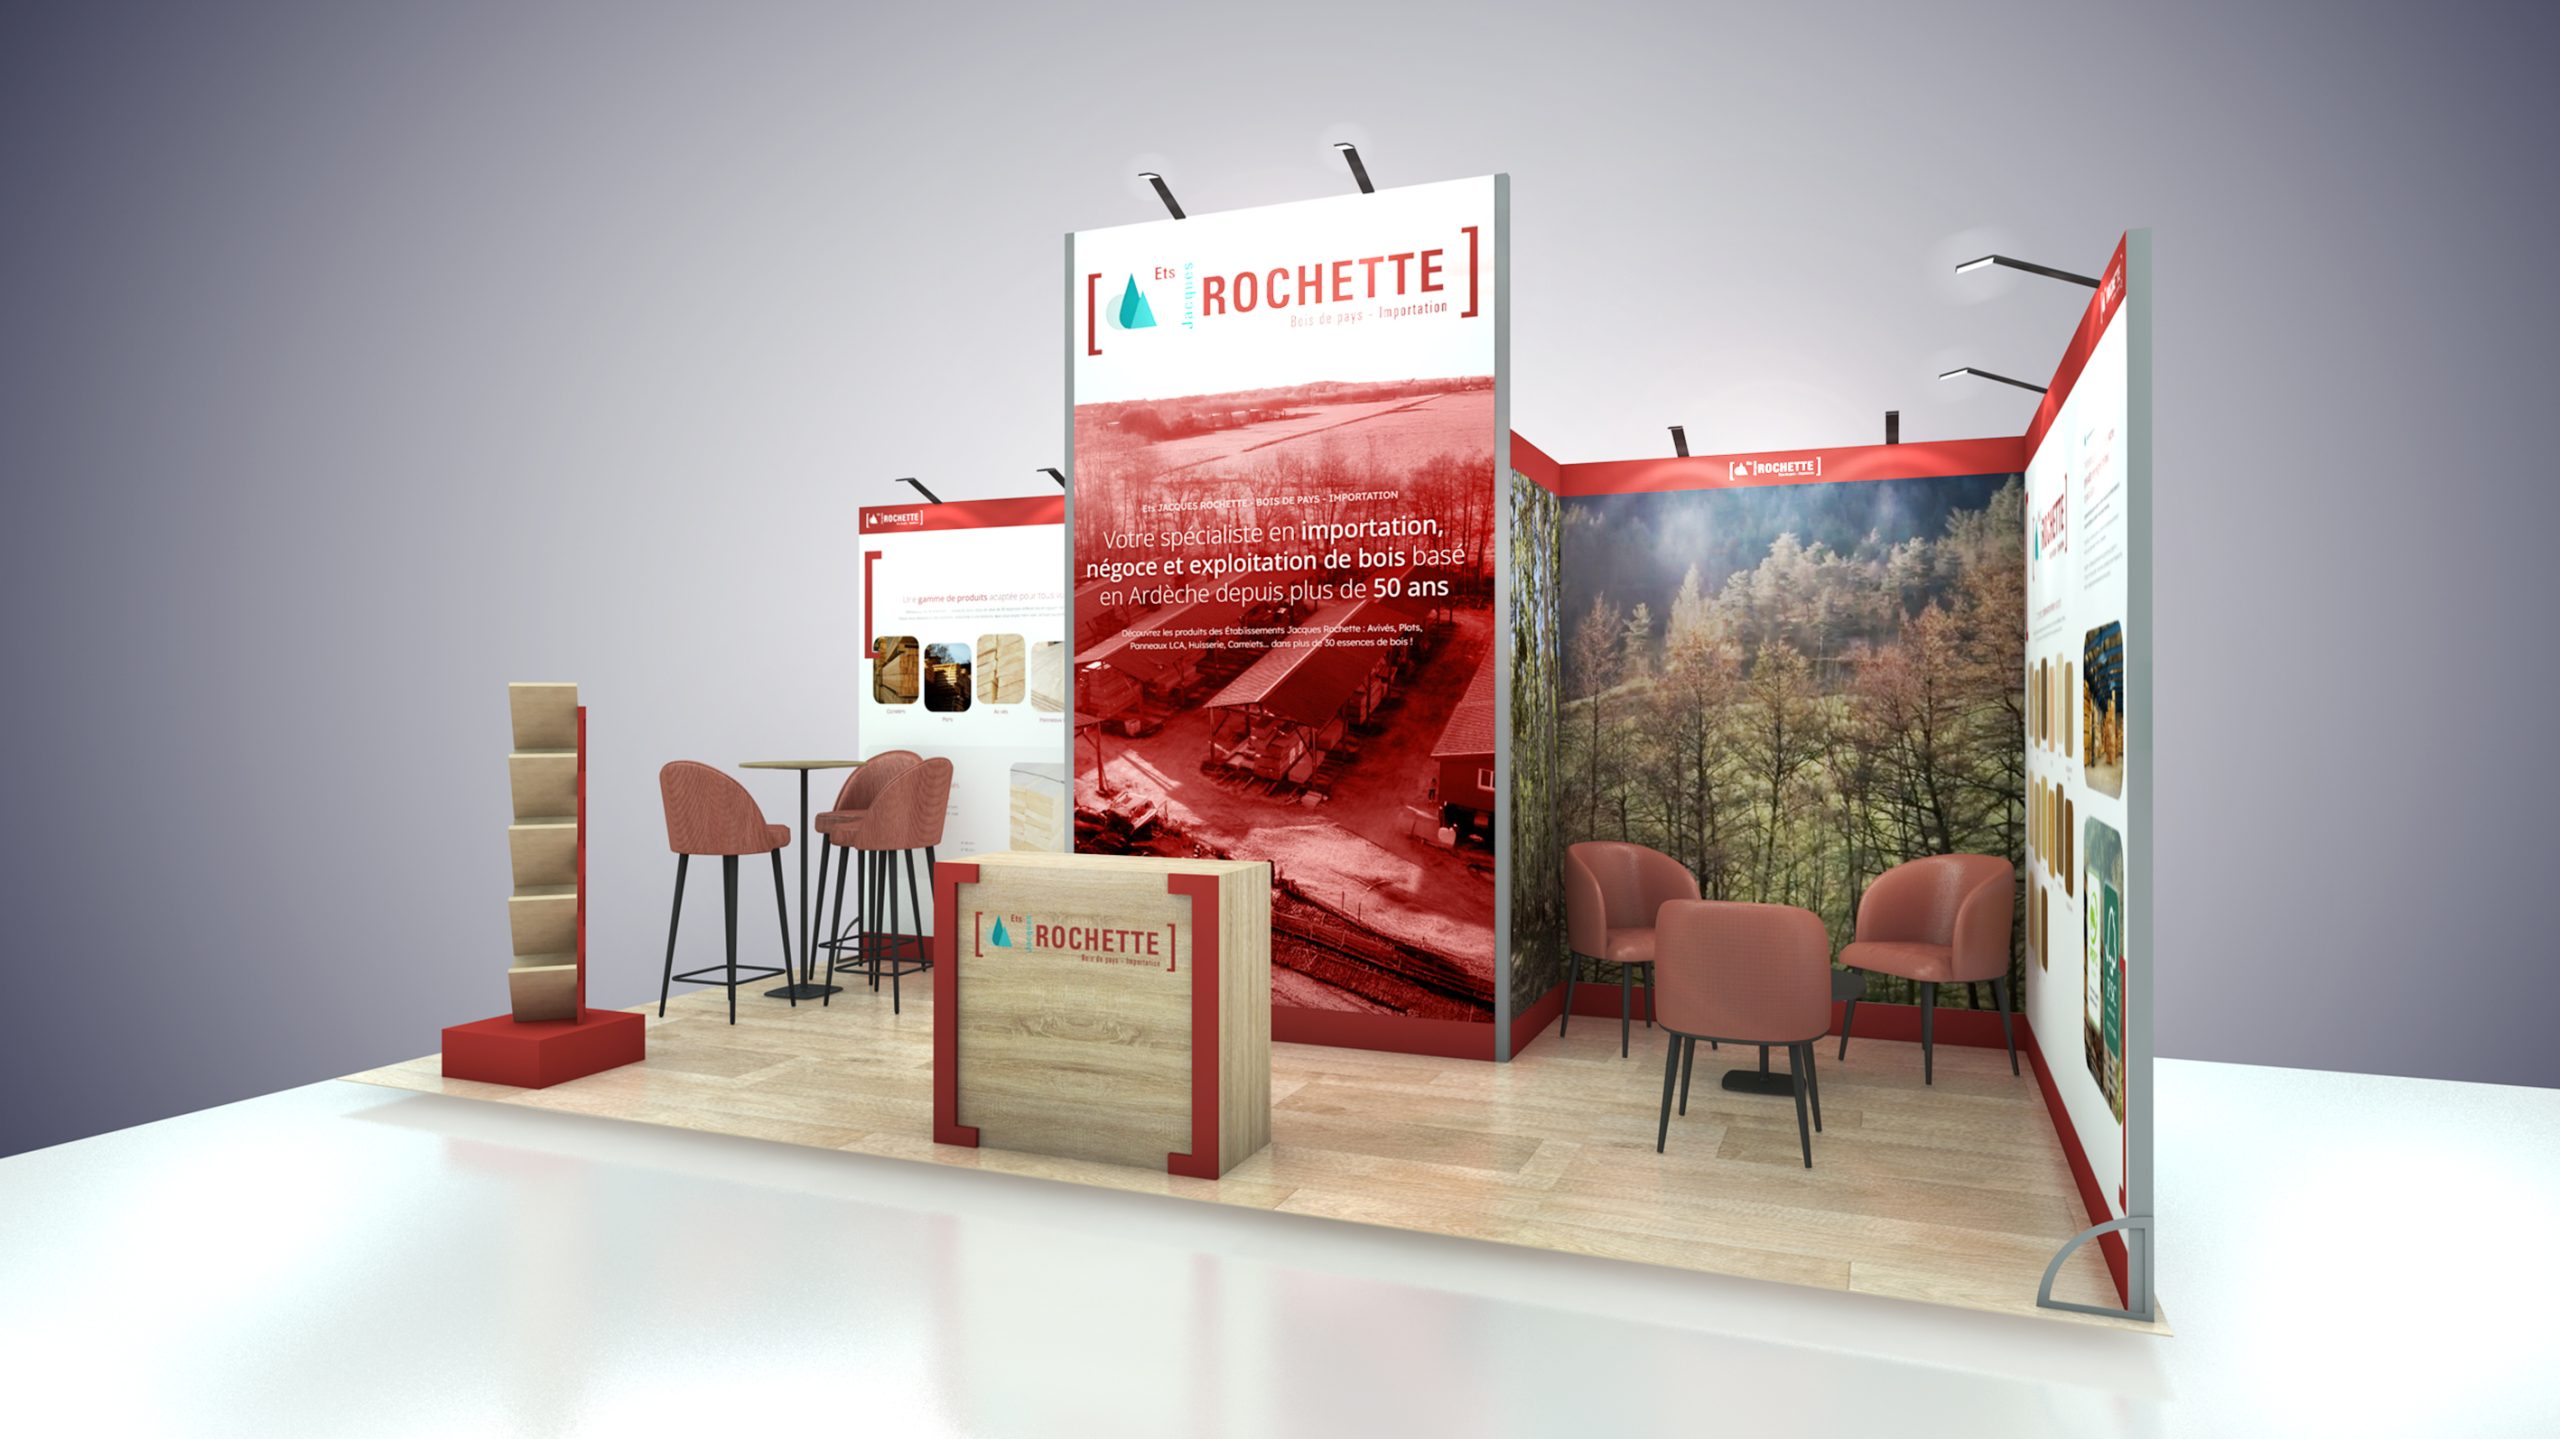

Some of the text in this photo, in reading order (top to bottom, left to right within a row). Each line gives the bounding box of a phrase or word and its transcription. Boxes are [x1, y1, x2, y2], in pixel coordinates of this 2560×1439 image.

[1154, 266, 1176, 281] Ets
[1203, 248, 1444, 316] ROCHETTE
[1181, 262, 1194, 330] Jacques
[1291, 315, 1314, 328] Bois
[1319, 312, 1331, 325] de
[1337, 311, 1363, 326] pays
[1379, 301, 1448, 320] Importation
[1758, 460, 1814, 474] ROCHETTE
[1158, 502, 1198, 512] JACQUES
[1200, 499, 1248, 510] ROCHETTE
[1256, 497, 1280, 507] BOIS
[1282, 496, 1295, 505] DE
[1297, 494, 1320, 504] PAYS
[1329, 490, 1399, 503] IMPORTATION
[883, 512, 919, 523] ROCHETTE
[1103, 515, 1443, 552] Votre spécialiste en importation,
[1086, 544, 1465, 583] négoce et exploitation de bois basé
[918, 596, 945, 606] gamme
[947, 594, 956, 602] de
[957, 593, 988, 605] produits
[1099, 577, 1449, 608] en Ardèche depuis plus de 50 ans
[1121, 629, 1161, 638] Découvrez
[1163, 628, 1173, 637] les
[1174, 627, 1207, 639] produits
[1209, 627, 1224, 636] des
[1225, 625, 1285, 637] Établissements
[1287, 625, 1322, 636] Jacques
[1323, 624, 1361, 634] Rochette
[1367, 623, 1397, 635] Avivés,
[1398, 623, 1423, 633] Plots,
[1130, 642, 1167, 650] Panneaux
[1169, 642, 1187, 651] LCA,
[1189, 641, 1226, 650] Huisserie,
[1271, 638, 1291, 648] dans
[1292, 638, 1310, 649] plus
[1311, 638, 1323, 647] de
[1336, 638, 1375, 647] essences
[1376, 637, 1388, 646] de
[1389, 636, 1408, 646] bois
[1010, 914, 1022, 923] Ets
[1036, 924, 1159, 955] ROCHETTE
